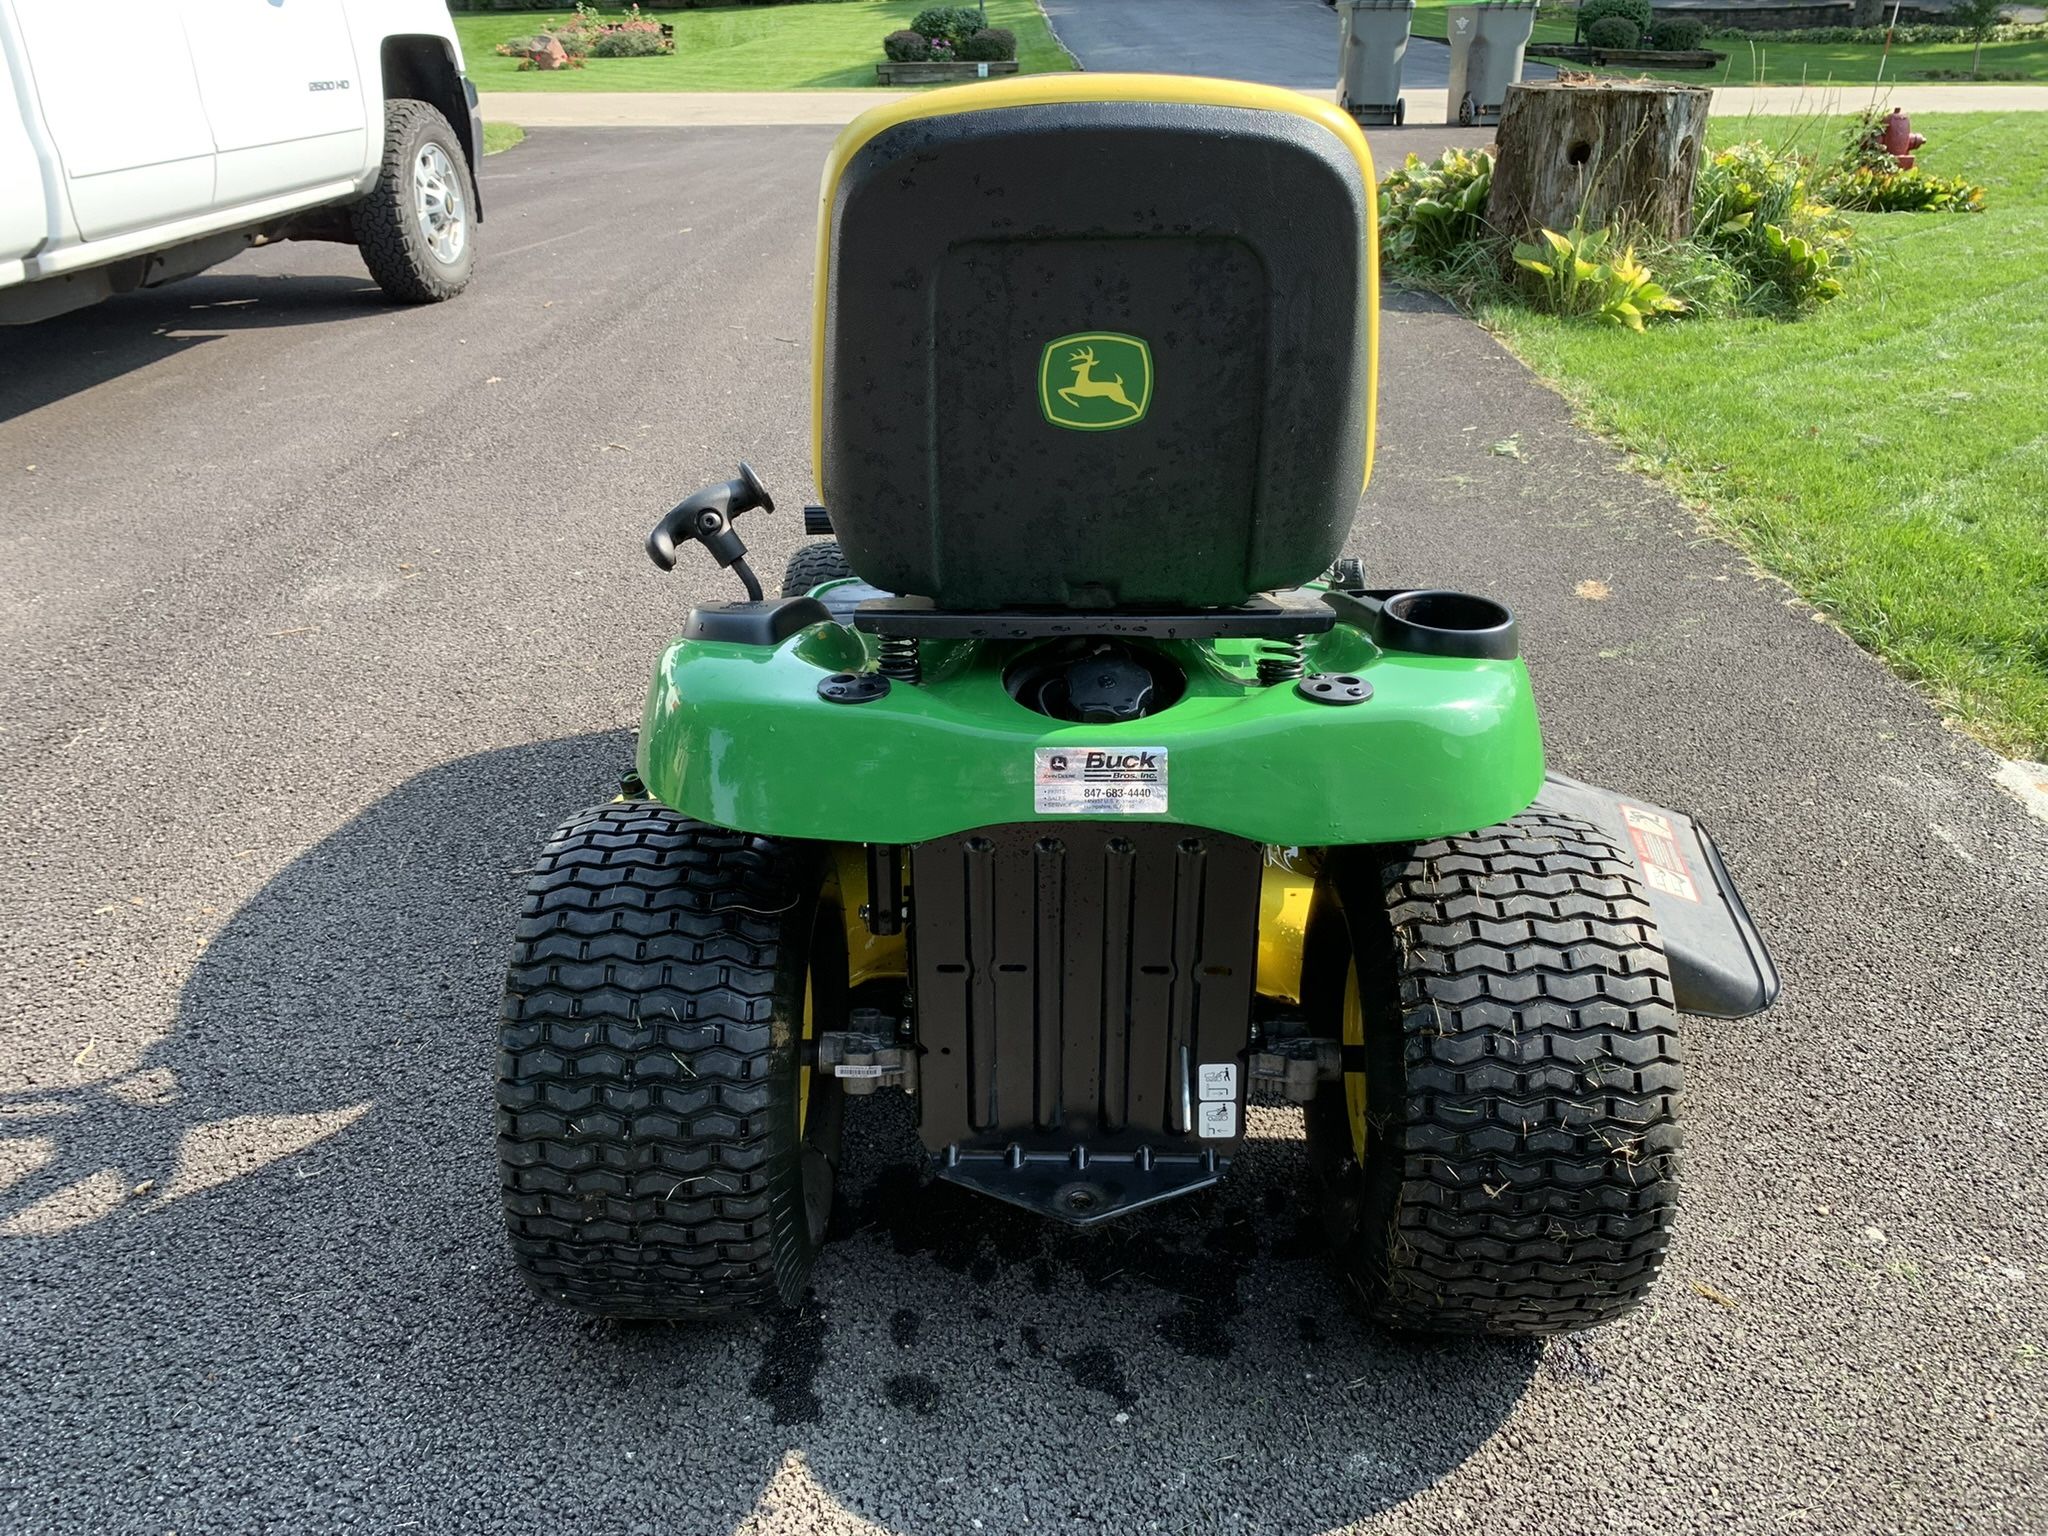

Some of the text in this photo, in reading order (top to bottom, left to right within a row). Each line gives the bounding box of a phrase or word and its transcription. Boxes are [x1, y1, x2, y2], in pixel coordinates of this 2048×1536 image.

[336, 80, 350, 90] HD
[1085, 751, 1157, 769] Buck
[1084, 788, 1151, 798] 847-683-4440
